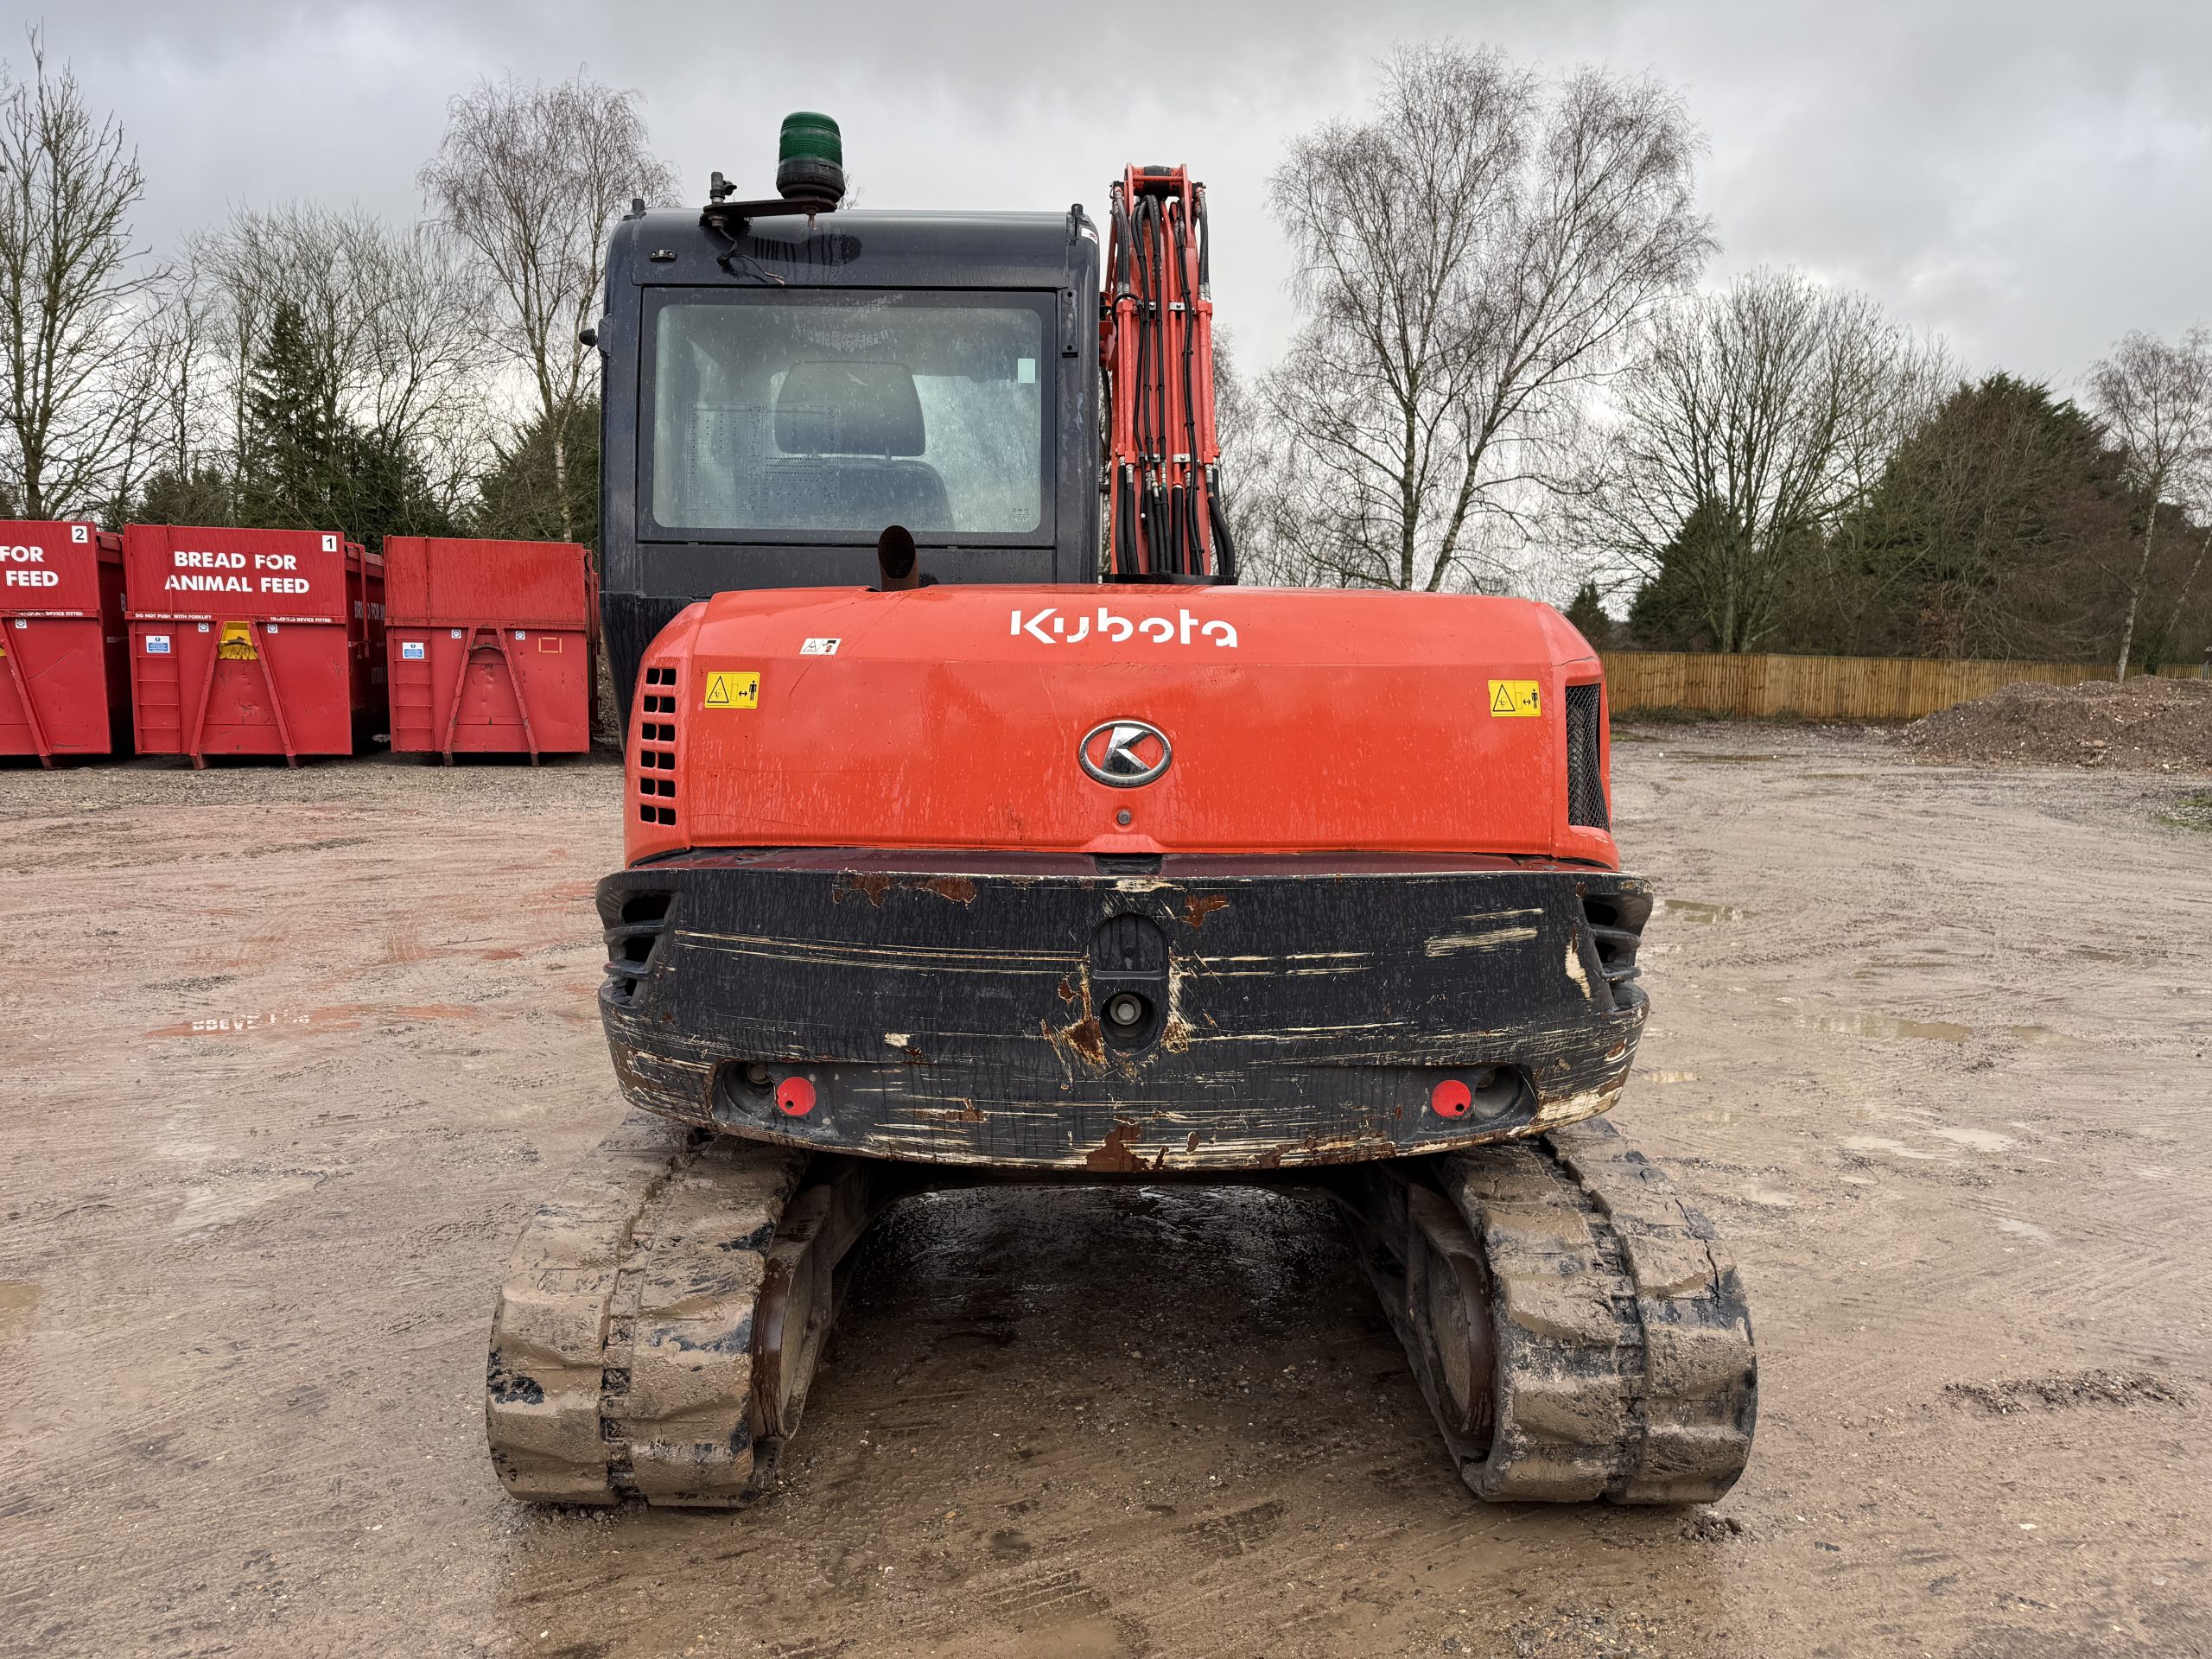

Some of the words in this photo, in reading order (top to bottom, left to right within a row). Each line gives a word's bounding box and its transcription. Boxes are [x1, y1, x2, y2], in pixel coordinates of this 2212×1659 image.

[74, 528, 85, 541] 2
[326, 537, 333, 550] 1
[0, 545, 45, 563] FOR
[174, 550, 246, 569] BREAD
[254, 554, 297, 570] FOR
[5, 570, 59, 587] FEED
[164, 575, 253, 592] ANIMAL
[260, 577, 309, 594] FEED
[1010, 607, 1238, 648] Kubota
